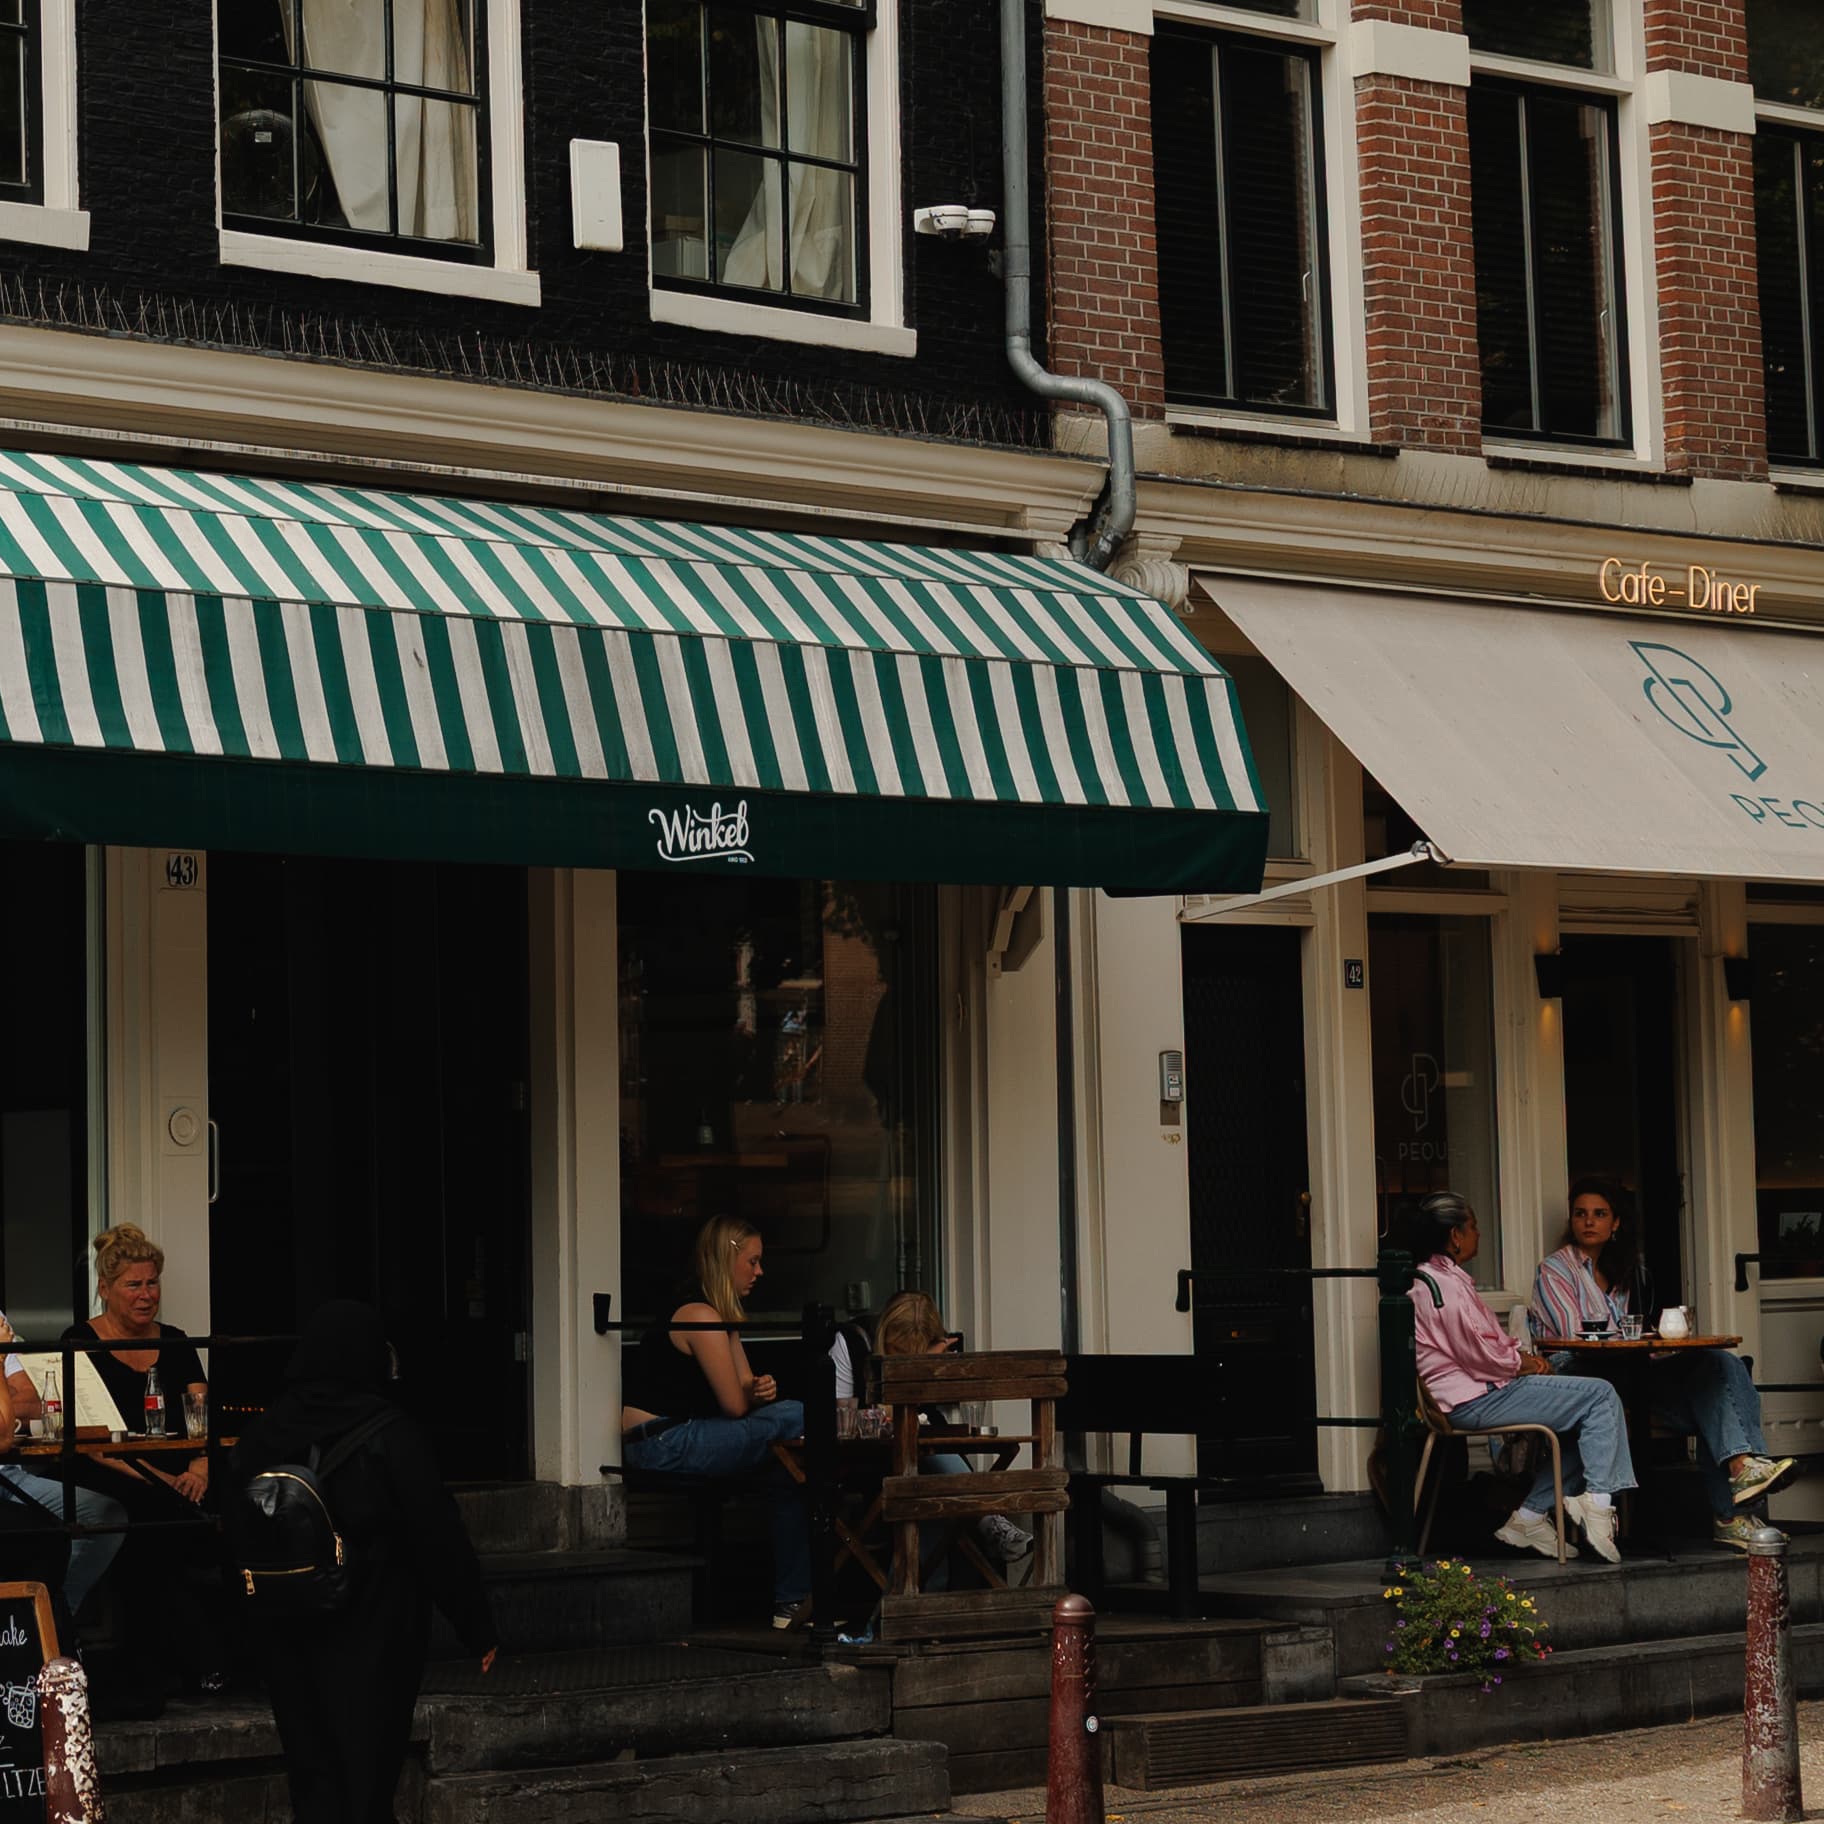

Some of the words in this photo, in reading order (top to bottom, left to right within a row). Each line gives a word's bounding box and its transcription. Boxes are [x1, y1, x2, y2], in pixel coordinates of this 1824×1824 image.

[648, 799, 751, 856] Winkel
[171, 855, 194, 885] 43
[1348, 964, 1362, 984] 42
